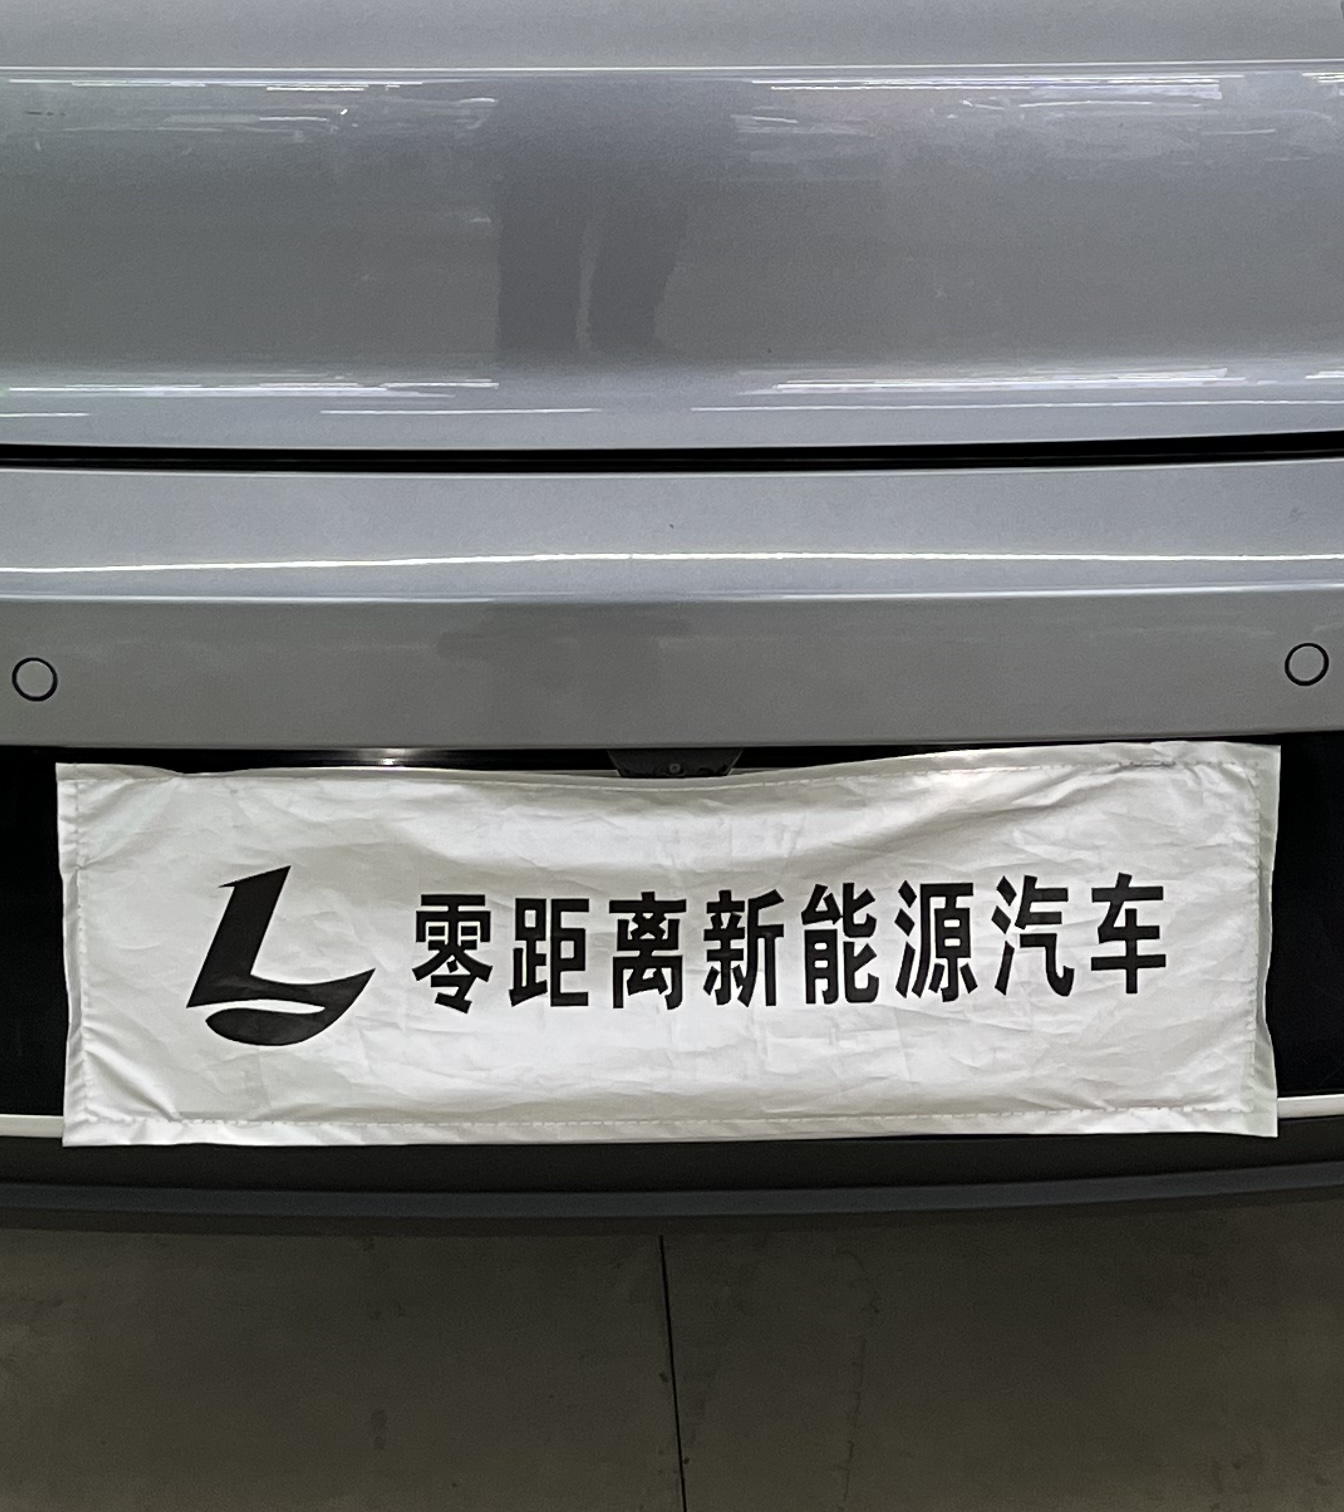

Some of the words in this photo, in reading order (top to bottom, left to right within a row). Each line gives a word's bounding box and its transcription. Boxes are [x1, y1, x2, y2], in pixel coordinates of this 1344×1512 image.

[412, 872, 1168, 1015] 零距离新能源汽车
